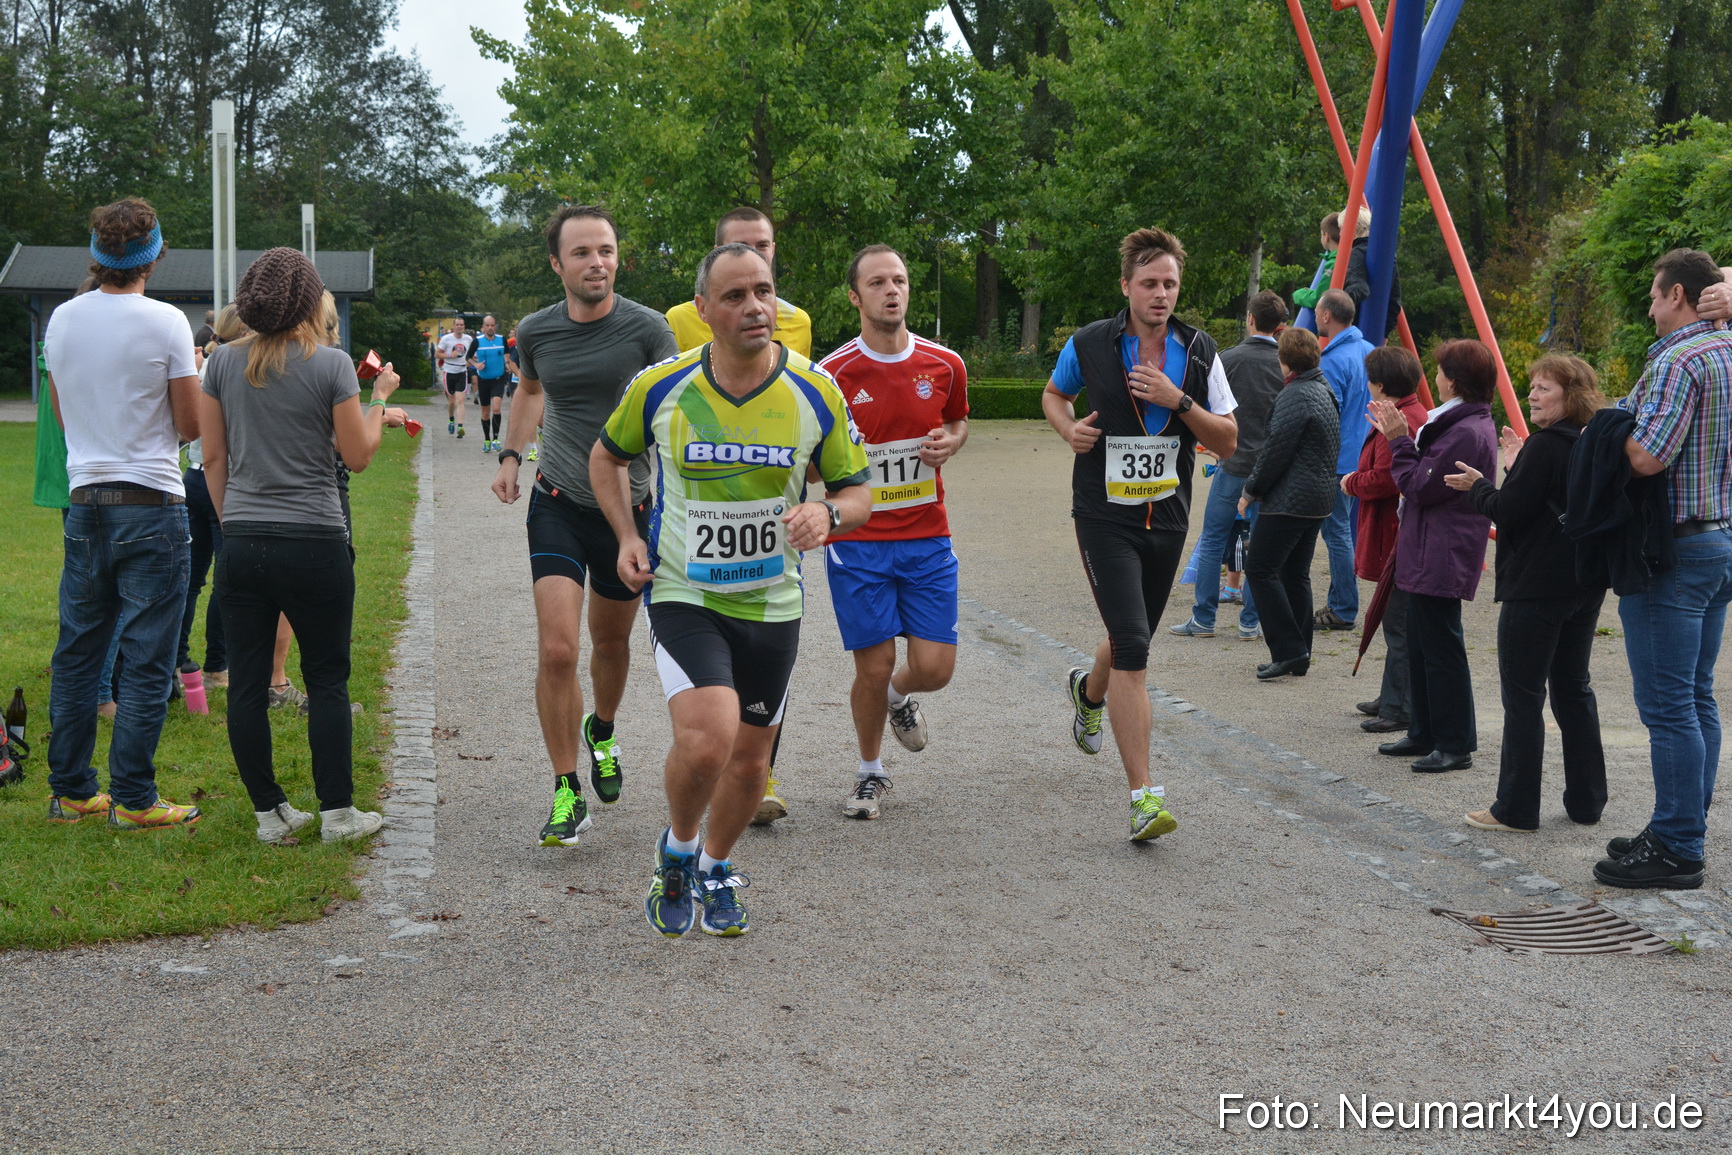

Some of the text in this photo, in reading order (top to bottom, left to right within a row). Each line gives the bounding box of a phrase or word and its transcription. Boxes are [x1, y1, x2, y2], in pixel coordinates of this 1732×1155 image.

[687, 424, 759, 441] TEAM
[684, 441, 797, 469] BOCK
[877, 455, 922, 483] 117
[1122, 453, 1166, 479] 338
[84, 489, 123, 505] PMA
[881, 486, 921, 501] Dominik
[1124, 485, 1163, 496] Andreas
[688, 508, 770, 520] PARTL Neumarkt
[696, 520, 777, 559] 2906
[710, 564, 764, 581] Manfred
